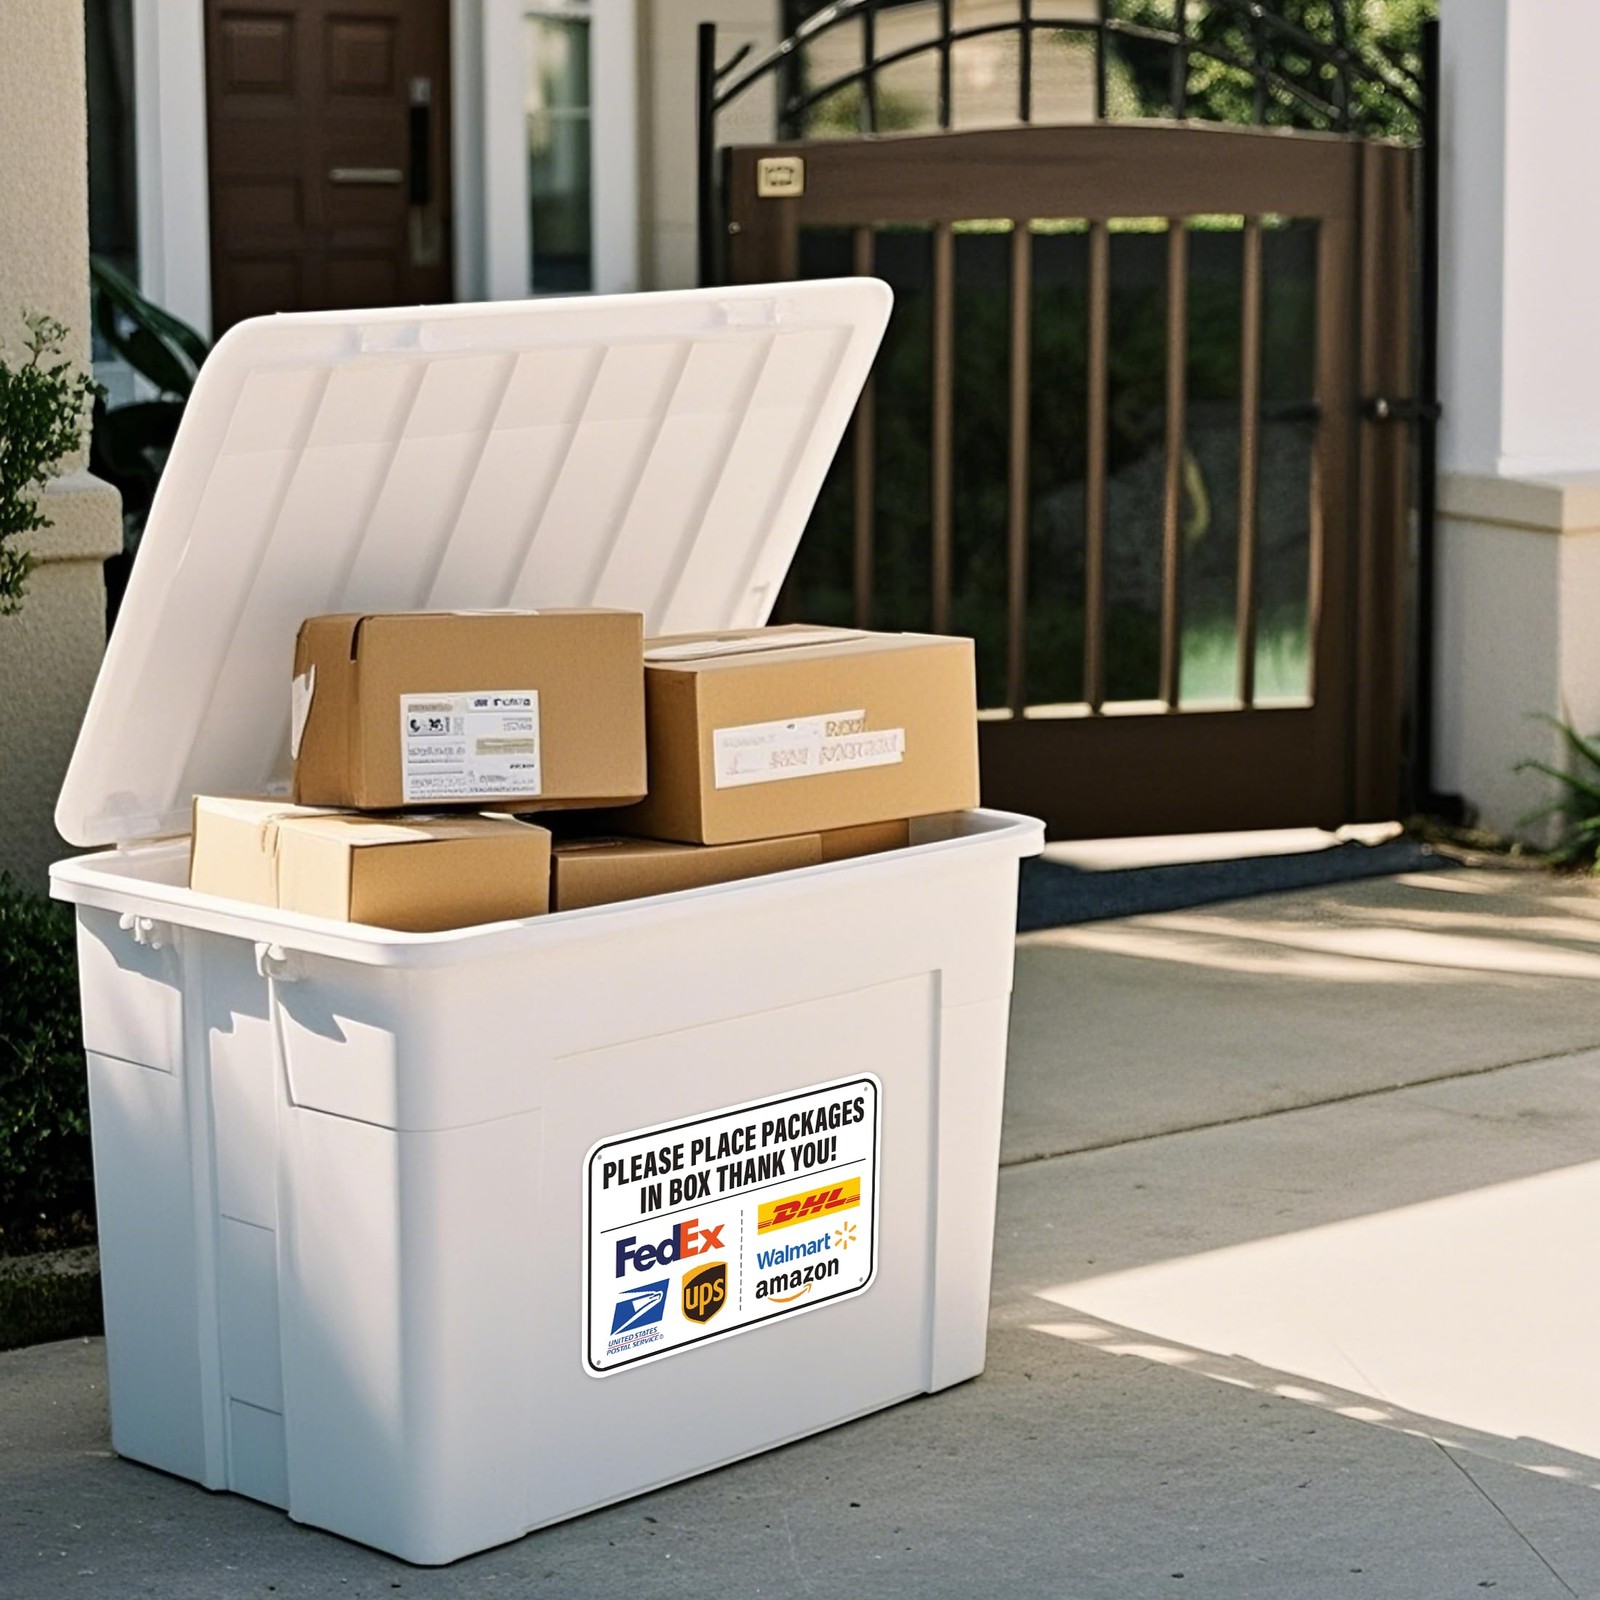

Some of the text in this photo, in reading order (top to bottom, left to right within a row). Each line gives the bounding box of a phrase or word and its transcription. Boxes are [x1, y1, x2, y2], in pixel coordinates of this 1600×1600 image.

[603, 1097, 865, 1190] PLEASE PLACE PACKAGES
[640, 1136, 837, 1214] IN BOX THANK YOU!
[772, 1187, 846, 1225] DHL
[615, 1218, 726, 1279] FedEx
[756, 1232, 831, 1270] Walmart
[685, 1278, 724, 1316] ups
[755, 1257, 840, 1300] amazon
[606, 1343, 631, 1356] POSTAL
[608, 1326, 658, 1347] UNITED STATES
